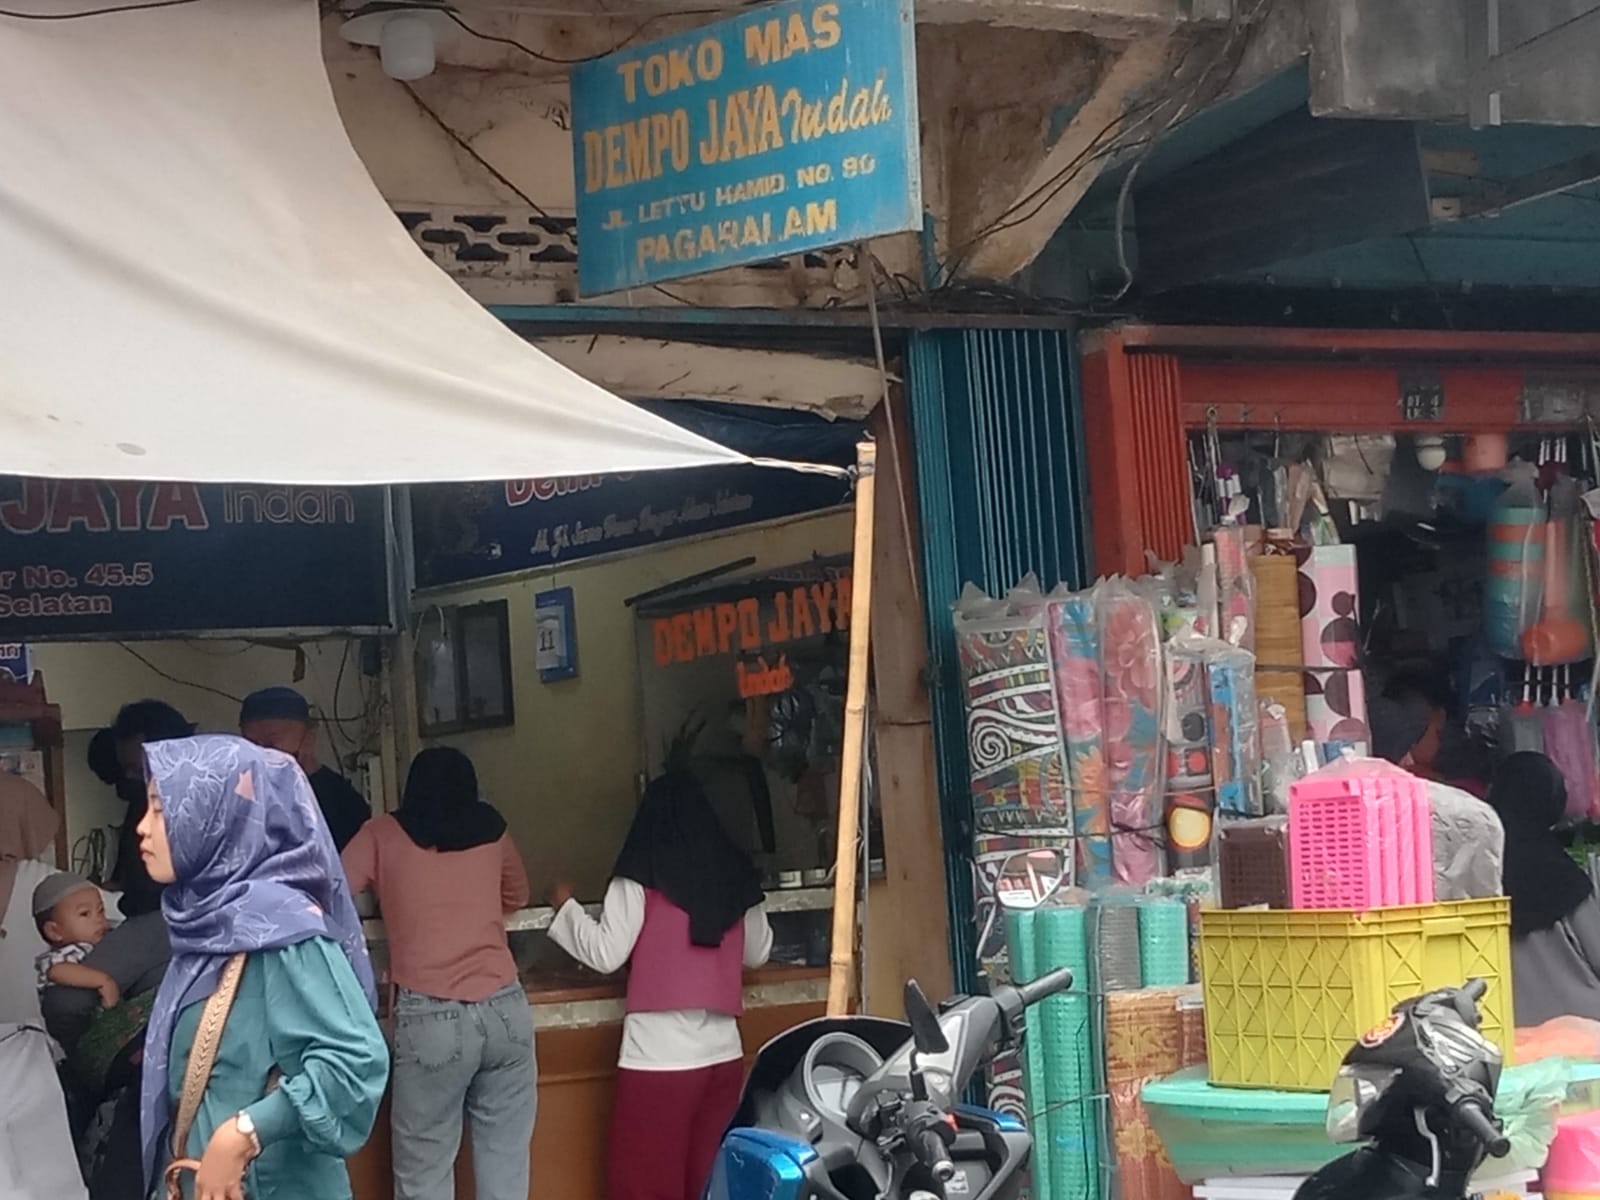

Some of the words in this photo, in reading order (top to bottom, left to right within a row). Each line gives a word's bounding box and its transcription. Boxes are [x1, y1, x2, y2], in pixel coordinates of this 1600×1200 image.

[617, 40, 723, 103] TOKO
[744, 4, 841, 66] MAS
[583, 108, 690, 194] DEMPO
[700, 84, 784, 165] JAYA
[639, 192, 705, 223] LETTU
[0, 478, 209, 534] JAYA
[23, 564, 78, 589] No.
[85, 562, 154, 586] 45.5
[0, 593, 112, 617] Selatan
[653, 597, 760, 668] DEMPO
[767, 574, 853, 643] JAYA
[539, 630, 555, 652] 11
